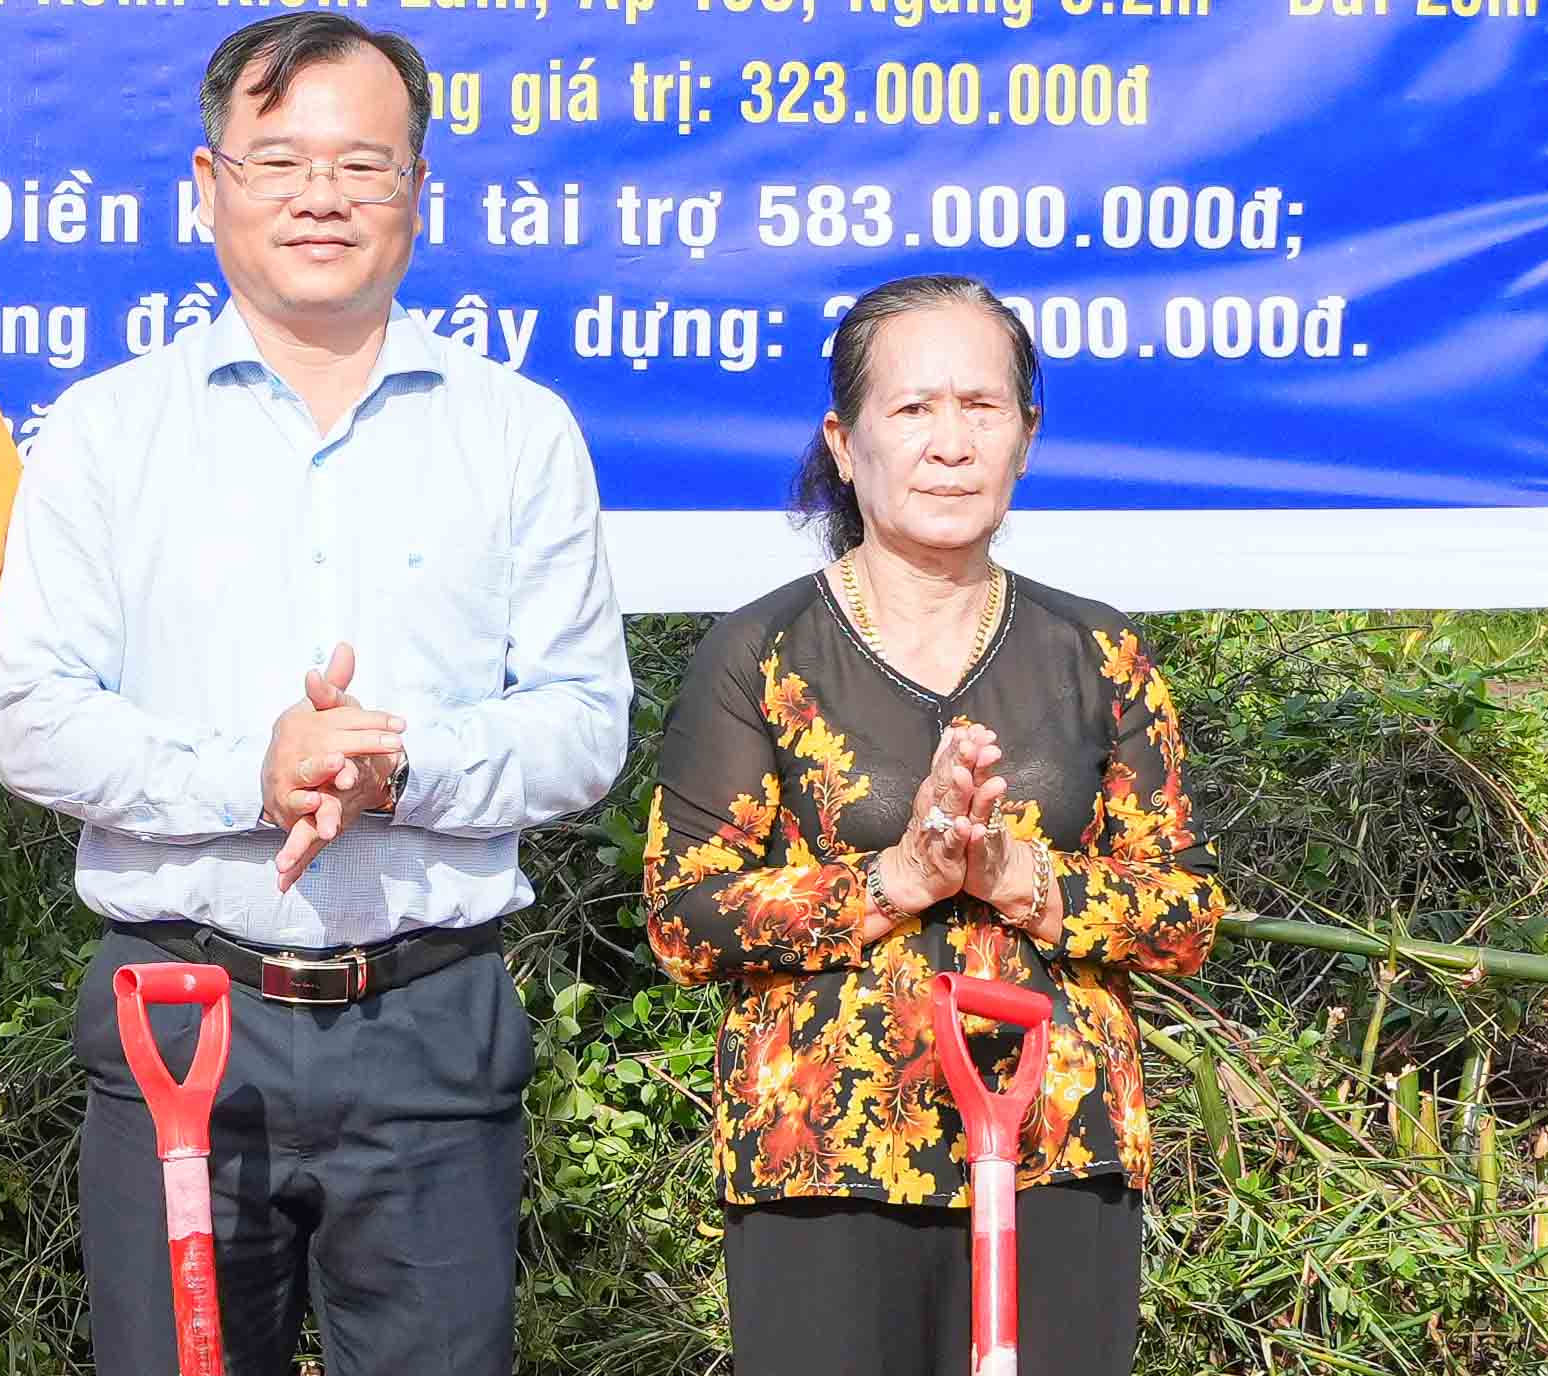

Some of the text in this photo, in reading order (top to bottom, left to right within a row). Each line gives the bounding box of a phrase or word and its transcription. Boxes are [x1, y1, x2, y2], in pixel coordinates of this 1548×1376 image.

[511, 57, 599, 136] giá
[630, 59, 712, 135] trị:
[740, 61, 1149, 126] 323.000.000đ
[483, 172, 579, 246] tài
[618, 186, 723, 260] trợ
[757, 183, 1305, 260] 583.000.000đ;
[574, 297, 785, 373] dựng:
